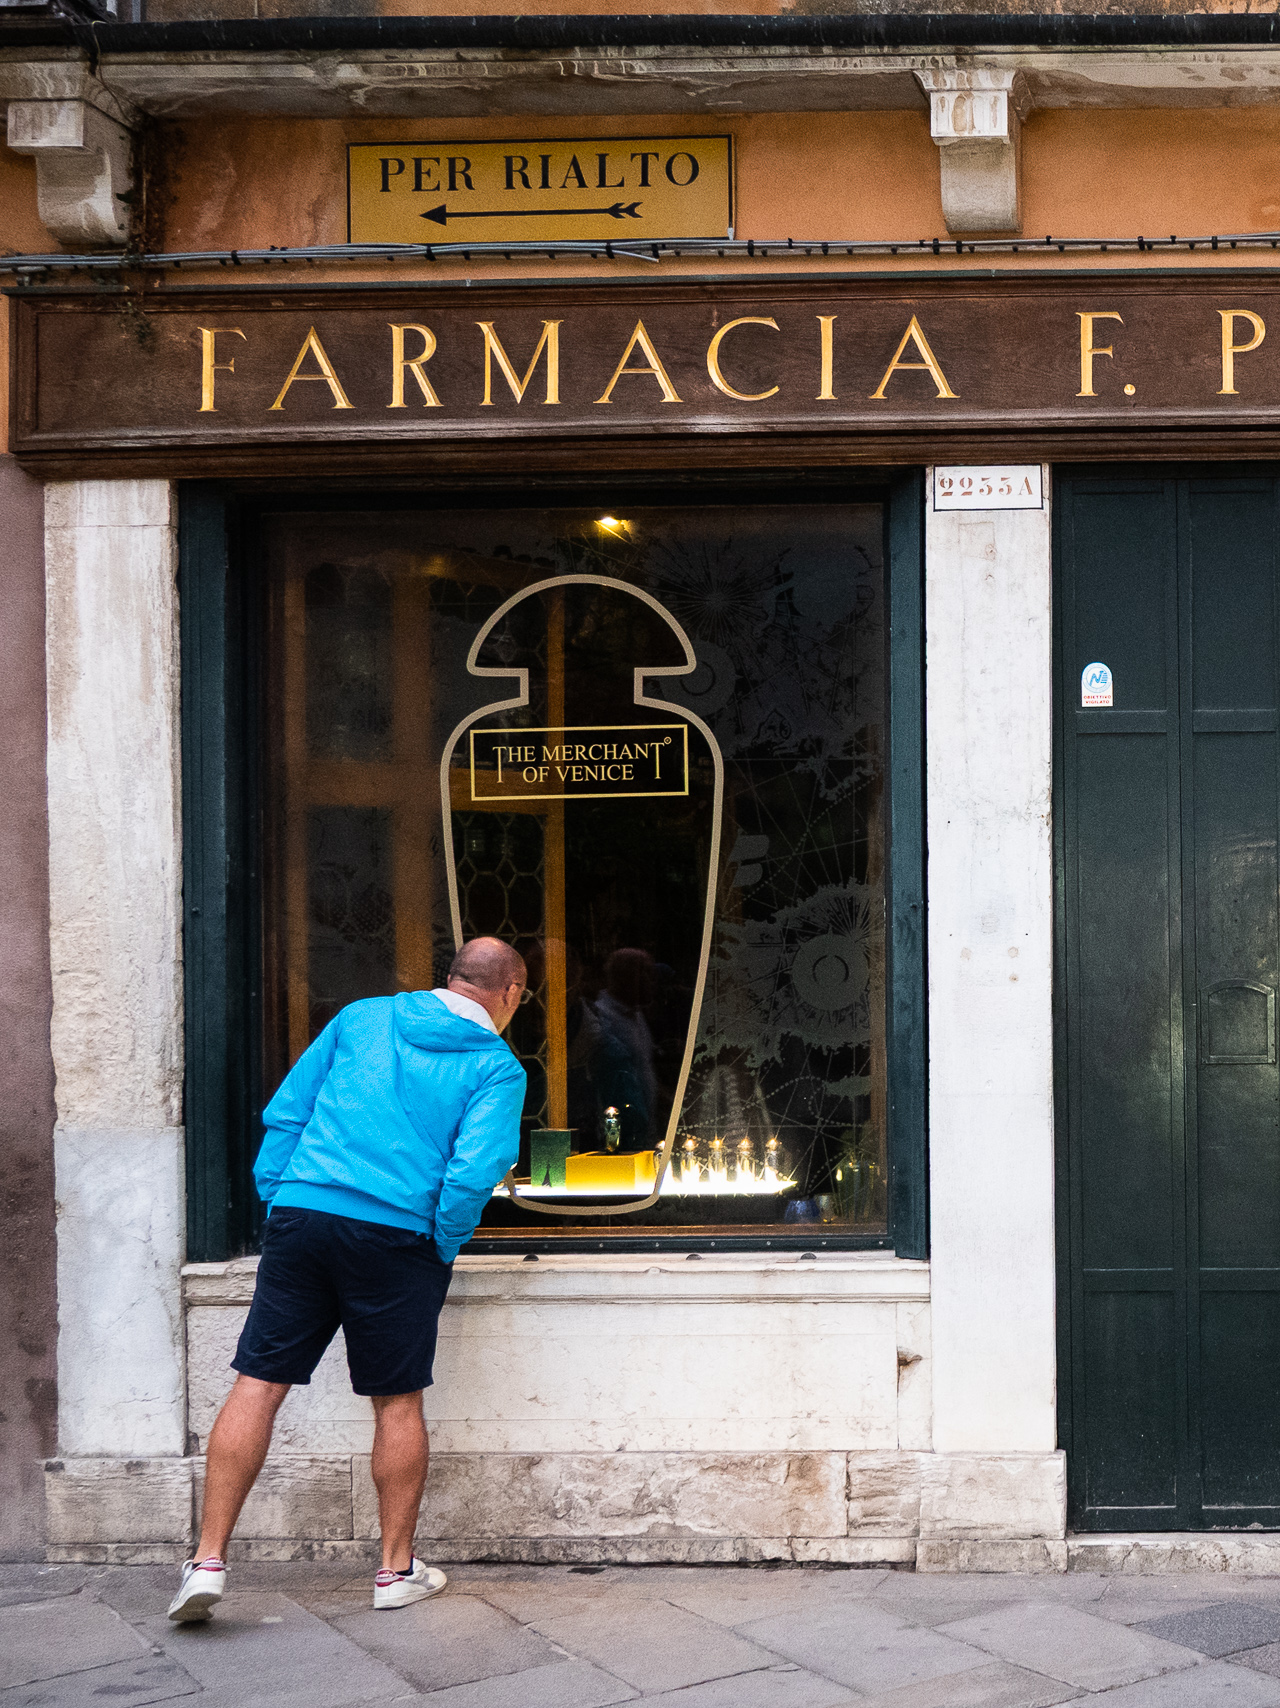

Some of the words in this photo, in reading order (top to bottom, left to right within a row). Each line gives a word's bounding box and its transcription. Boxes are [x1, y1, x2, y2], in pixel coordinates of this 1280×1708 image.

[378, 156, 476, 193] PER
[502, 151, 701, 190] RIALTO
[196, 315, 960, 412] FARMACIA
[1075, 312, 1136, 397] F.
[492, 746, 537, 784] THE
[522, 766, 550, 783] OF
[555, 764, 635, 781] VENICE
